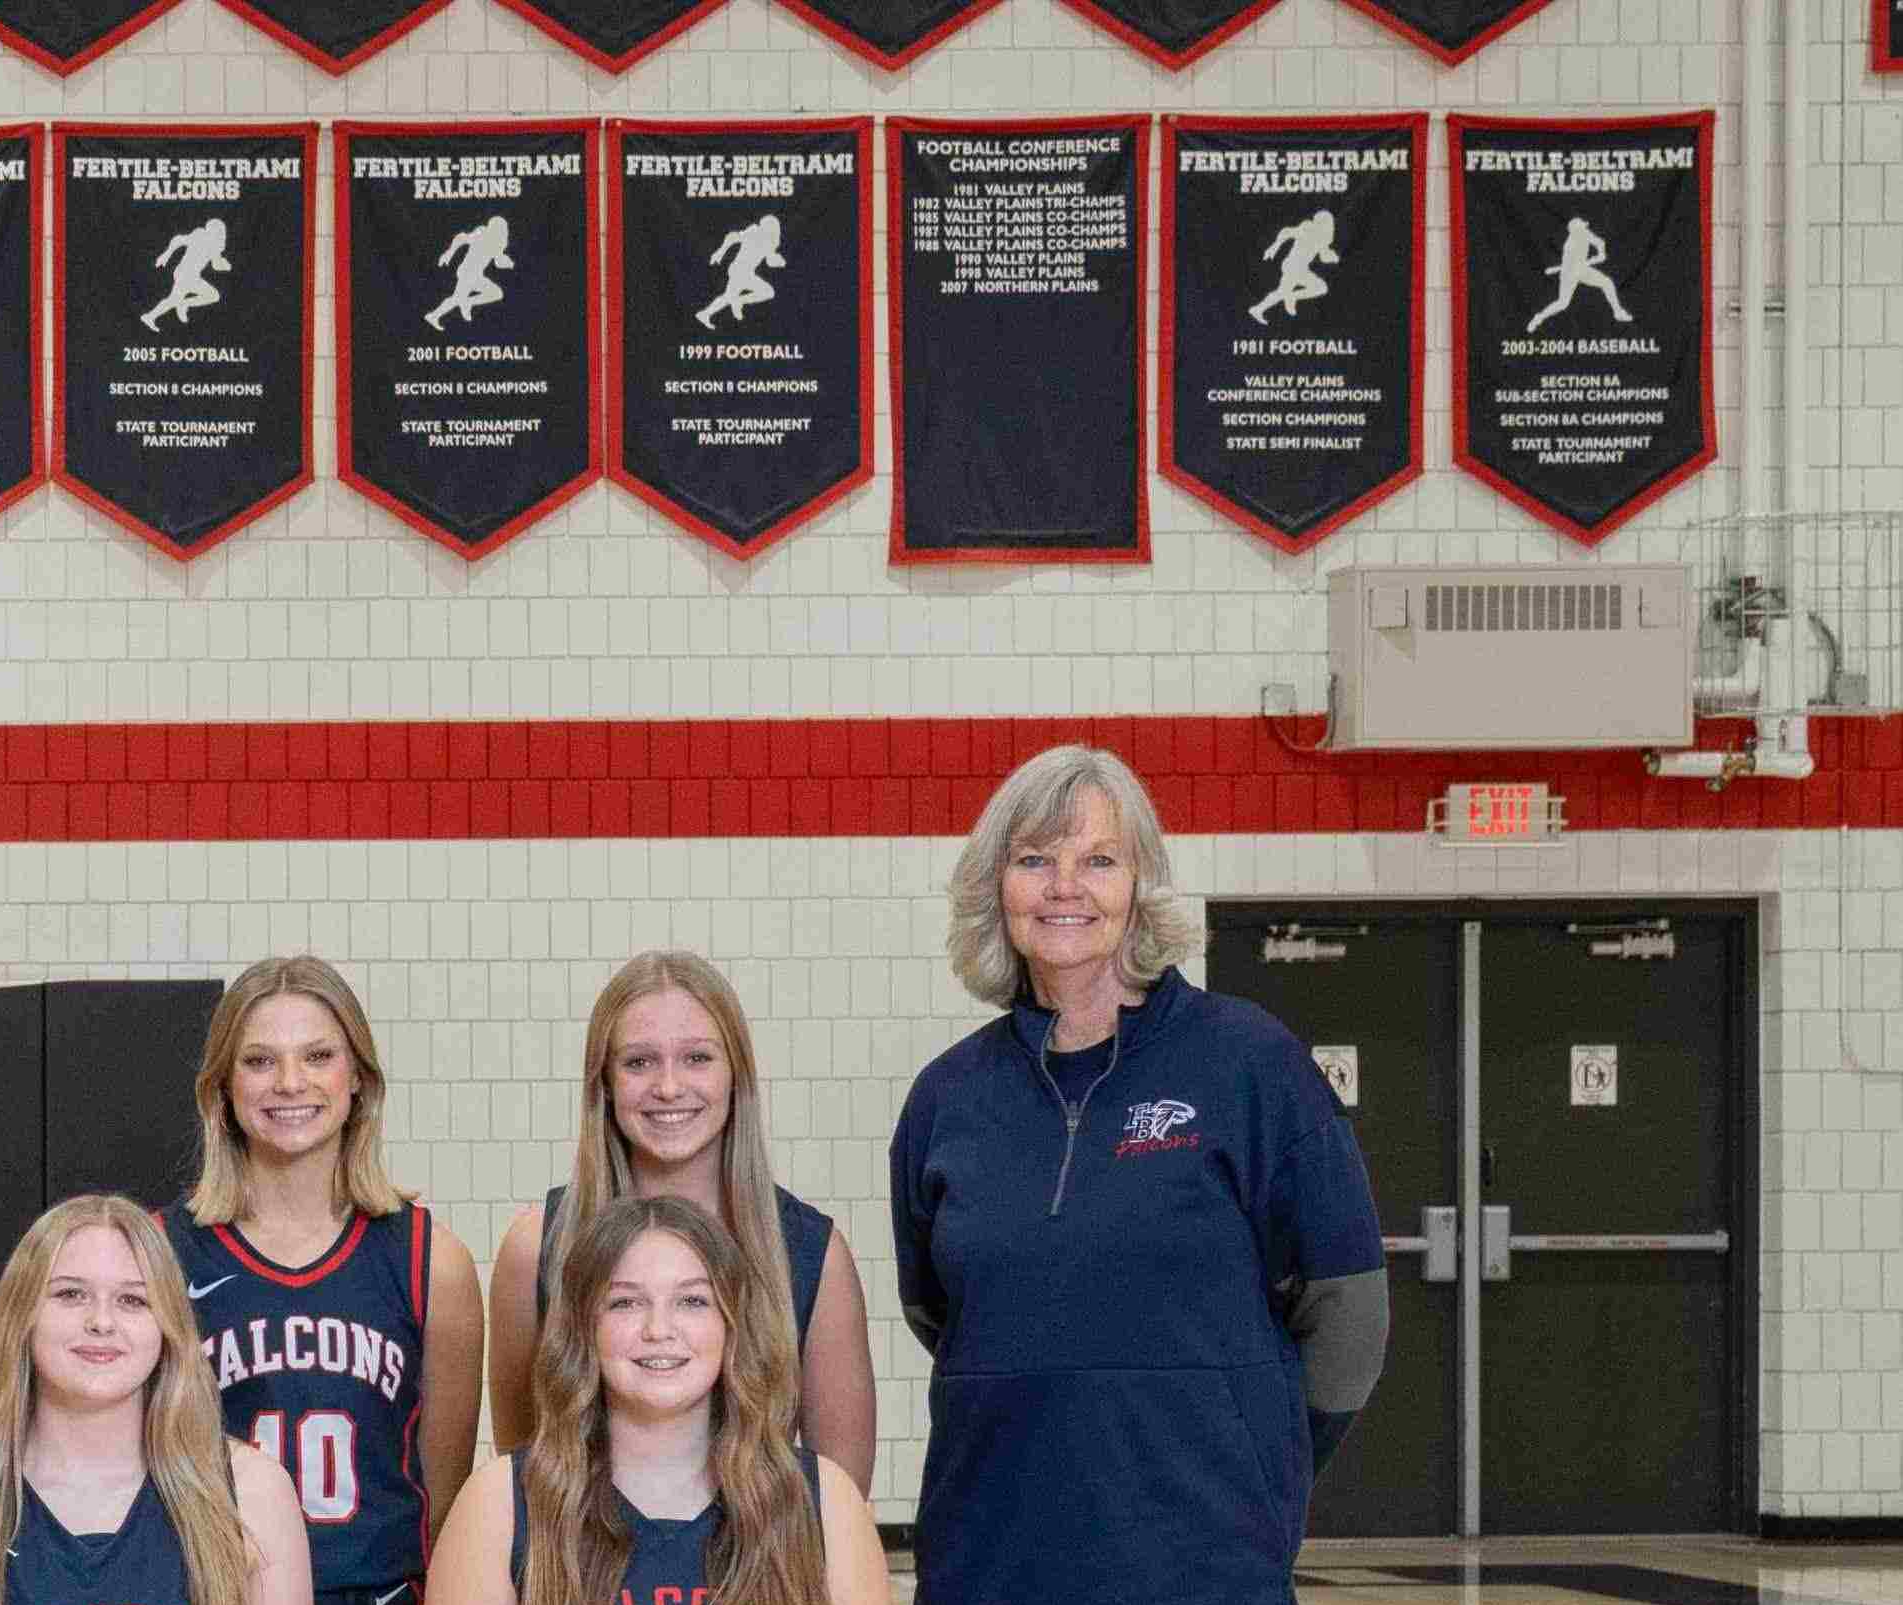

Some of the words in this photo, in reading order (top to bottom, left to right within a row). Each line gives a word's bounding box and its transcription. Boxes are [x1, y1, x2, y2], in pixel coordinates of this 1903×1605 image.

[917, 141, 1004, 155] FOOTBALL
[1008, 138, 1120, 154] CONFERENCE
[353, 154, 581, 178] FERTILE-BELTRAMI
[626, 153, 853, 176] FERTILE-BELTRAMI
[949, 157, 1088, 173] CHAMPIONSHIPS
[1179, 150, 1408, 172] FERTILE-BELTRAMI
[1465, 147, 1693, 171] FERTILE-BELTRAMI
[73, 157, 300, 179] FERTILE-BELTRAMI
[414, 178, 522, 199] FALCONS
[686, 176, 794, 198] FALCONS
[1240, 172, 1348, 193] FALCONS
[1526, 171, 1635, 192] FALCONS
[133, 180, 241, 201] FALCONS
[985, 184, 1034, 196] VALLEY
[1037, 183, 1085, 195] PLAINS
[945, 198, 993, 210] VALLEY
[996, 197, 1044, 209] PLAINS
[945, 212, 993, 224] VALLEY
[996, 211, 1044, 223] PLAINS
[945, 226, 993, 238] VALLEY
[996, 225, 1044, 237] PLAINS
[945, 240, 993, 252] VALLEY
[996, 239, 1044, 251] PLAINS
[986, 253, 1035, 265] VALLEY
[1038, 253, 1085, 264] PLAINS
[986, 267, 1035, 279] VALLEY
[1038, 267, 1085, 278] PLAINS
[974, 281, 1049, 293] NORTHERN
[1052, 280, 1099, 292] PLAINS
[408, 347, 440, 361] 2001
[445, 346, 533, 360] FOOTBALL
[679, 345, 712, 359] 1999
[716, 345, 803, 359] FOOTBALL
[1233, 340, 1264, 354] 1981
[1269, 340, 1357, 354] FOOTBALL
[1501, 341, 1574, 355] 2003-2004
[1578, 339, 1660, 353] BASEBALL
[123, 348, 157, 362] 2005
[161, 348, 249, 362] FOOTBALL
[394, 382, 453, 395] SECTION
[466, 381, 548, 394] CHAMPIONS
[664, 381, 724, 393] SECTION
[737, 380, 818, 393] CHAMPIONS
[1245, 376, 1294, 388] VALLEY
[1297, 376, 1344, 388] PLAINS
[1541, 376, 1600, 388] SECTION
[109, 383, 168, 395] SECTION
[181, 383, 263, 396] CHAMPIONS
[1207, 389, 1297, 401] CONFERENCE
[1300, 389, 1382, 401] CHAMPIONS
[1495, 390, 1583, 402] SUB-SECTION
[1586, 388, 1669, 401] CHAMPIONS
[401, 421, 441, 432] STATE
[445, 419, 541, 432] TOURNAMENT
[671, 419, 711, 431] STATE
[716, 418, 811, 430] TOURNAMENT
[1222, 414, 1282, 426] SECTION
[1285, 414, 1366, 426] CHAMPIONS
[1500, 414, 1559, 427] SECTION
[1582, 412, 1664, 425] CHAMPIONS
[116, 421, 155, 433] STATE
[160, 421, 257, 433] TOURNAMENT
[143, 435, 229, 447] PARTICIPANT
[428, 434, 515, 447] PARTICIPANT
[698, 432, 785, 445] PARTICIPANT
[1226, 437, 1266, 449] STATE
[1269, 437, 1300, 449] SEMI
[1303, 437, 1363, 449] FINALIST
[1511, 438, 1551, 450] STATE
[1555, 436, 1653, 449] TOURNAMENT
[1538, 452, 1624, 464] PARTICIPANT
[1469, 786, 1533, 834] EXIT
[252, 1409, 361, 1524] 10
